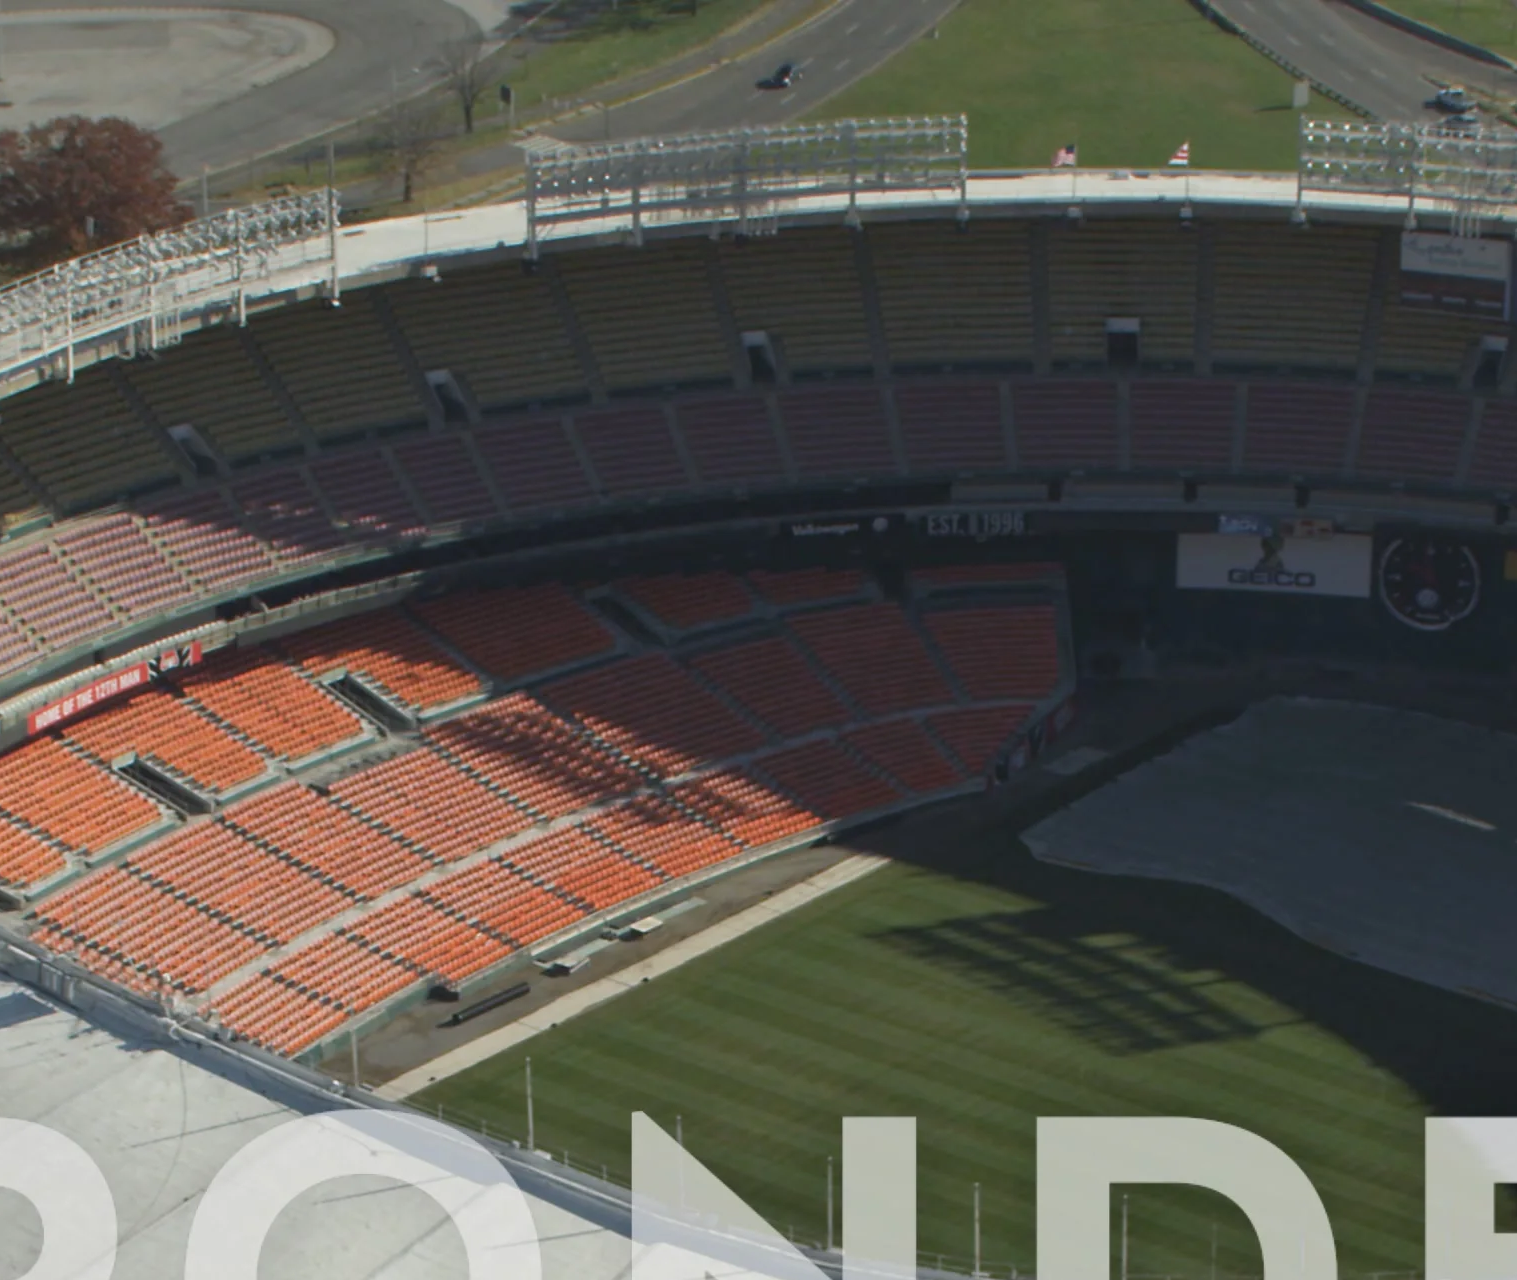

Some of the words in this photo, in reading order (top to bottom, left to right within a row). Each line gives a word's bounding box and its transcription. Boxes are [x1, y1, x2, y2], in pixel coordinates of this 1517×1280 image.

[1228, 569, 1316, 587] GEICO
[35, 704, 62, 729] HOME
[62, 698, 75, 717] OF
[76, 688, 94, 709] THE
[119, 668, 140, 690] MAN
